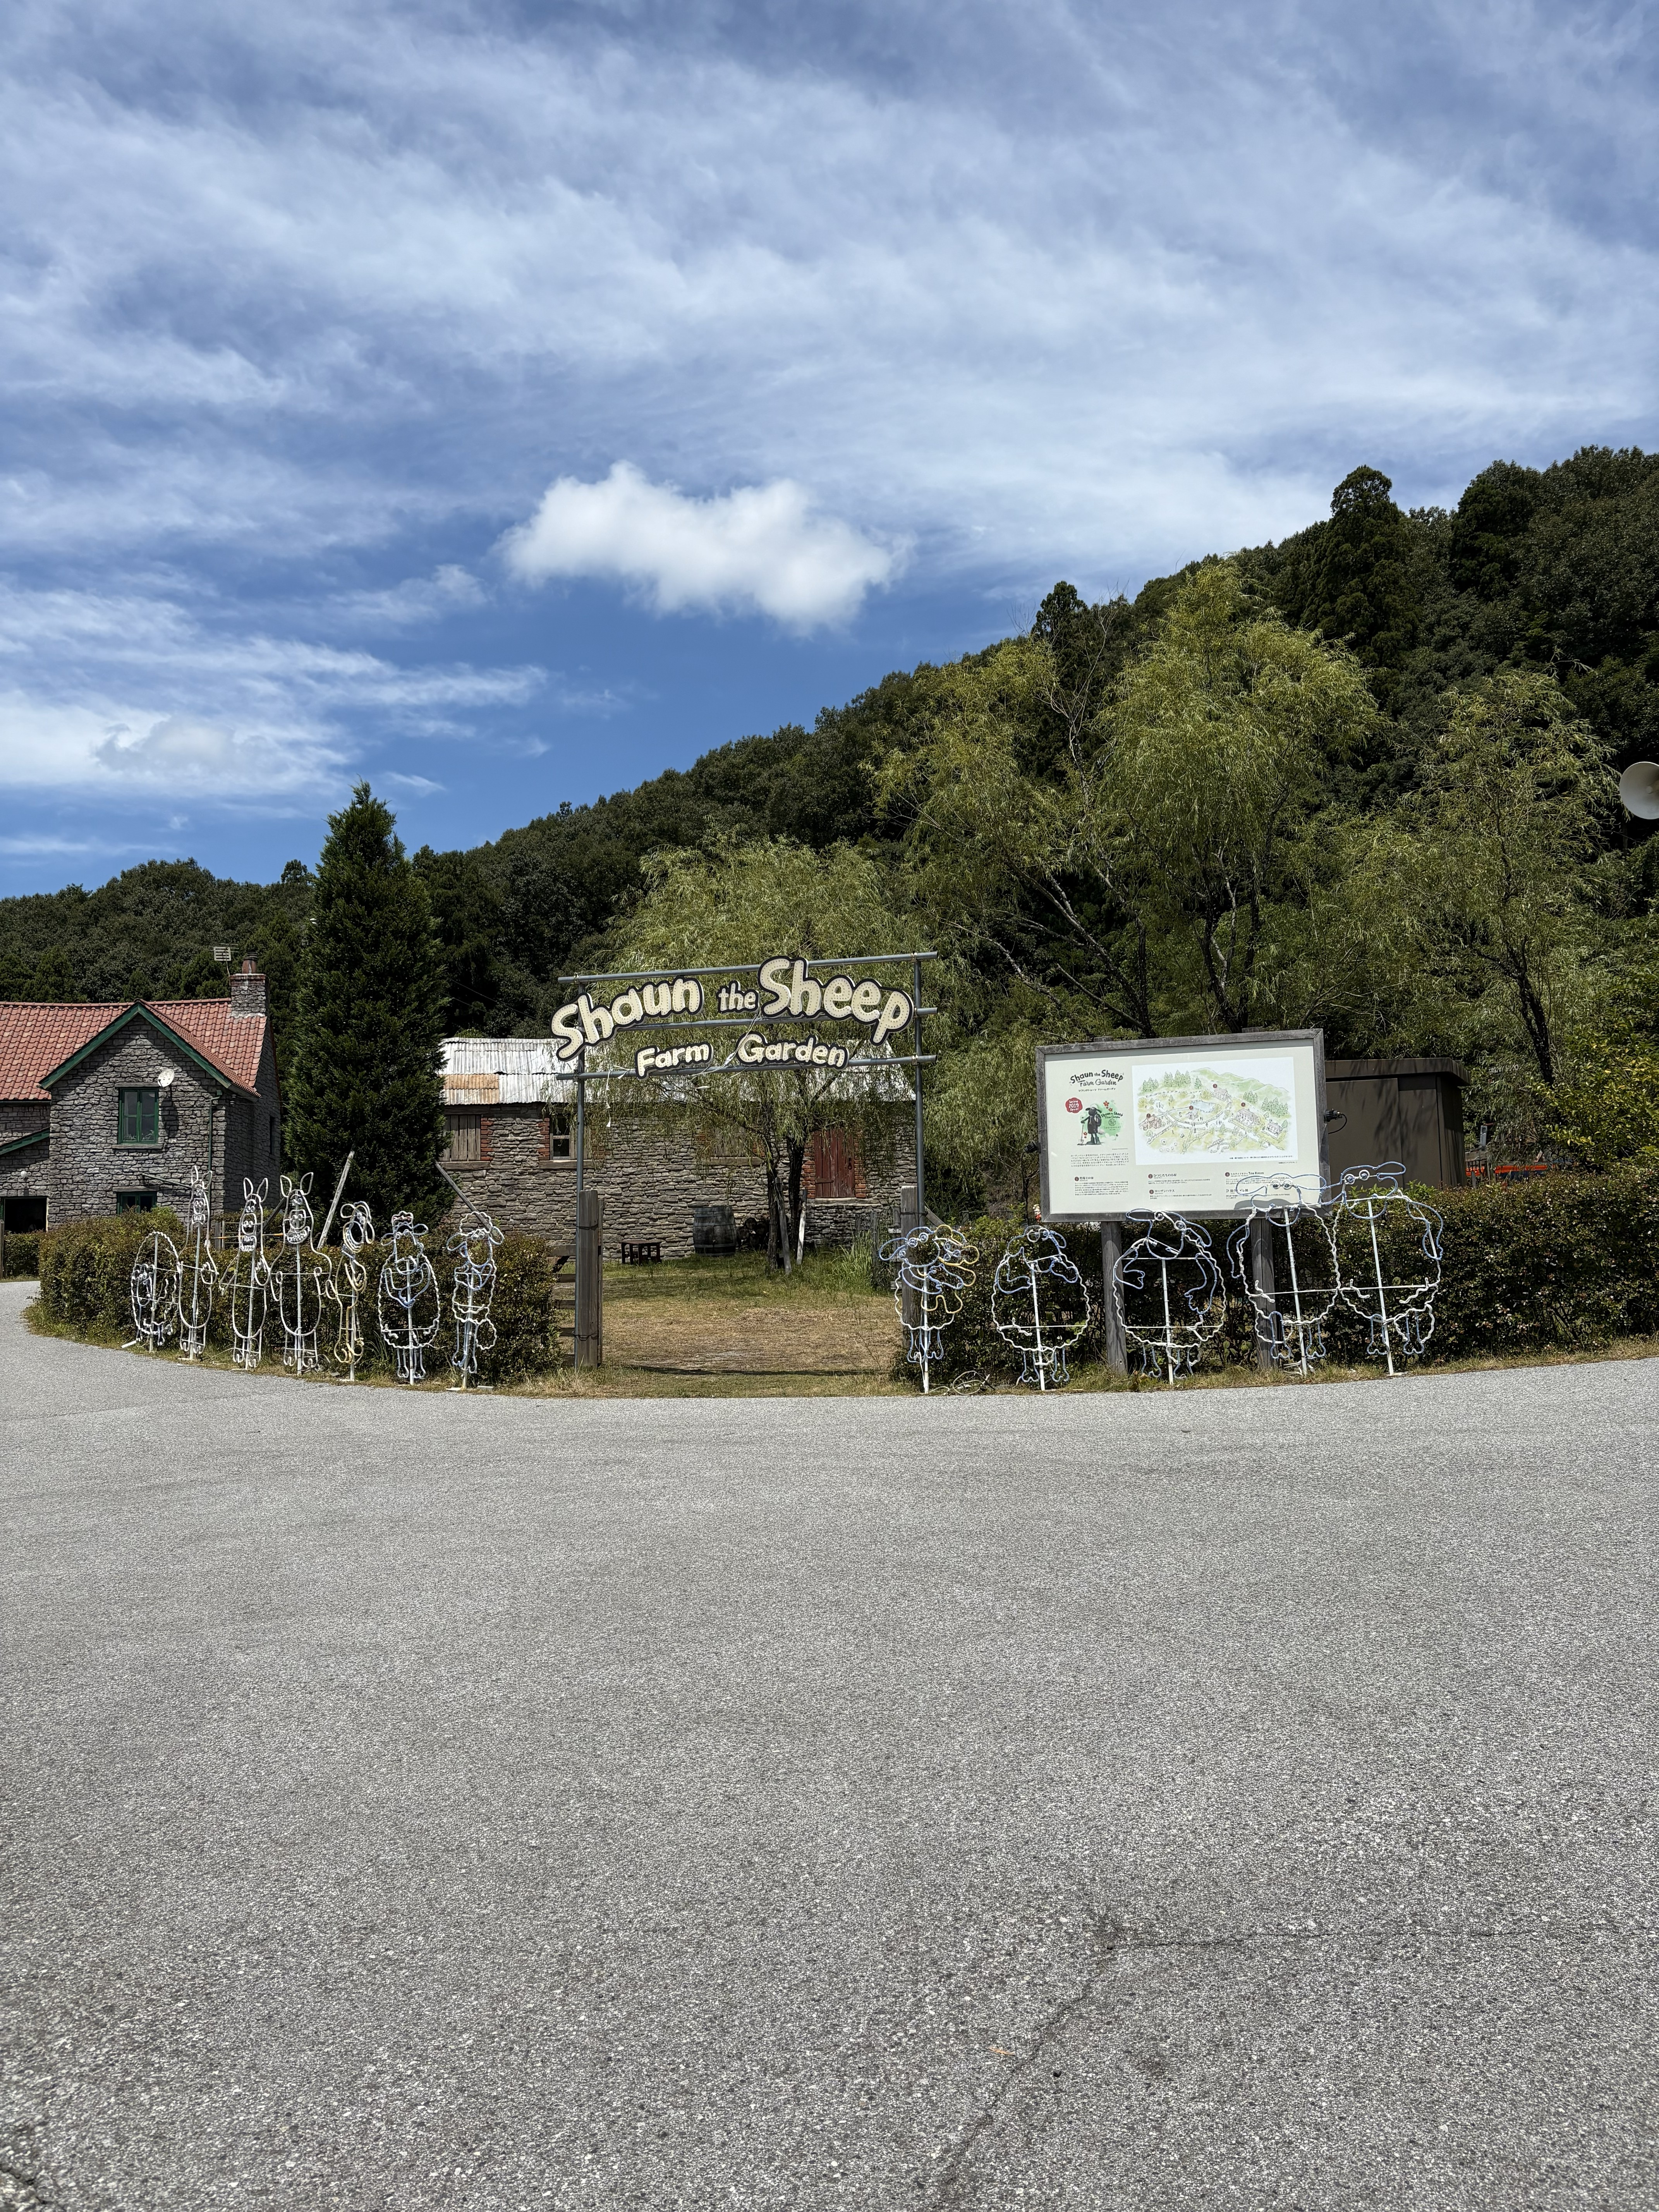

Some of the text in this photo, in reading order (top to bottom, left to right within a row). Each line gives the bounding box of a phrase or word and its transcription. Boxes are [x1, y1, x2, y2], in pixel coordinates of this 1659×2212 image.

[550, 957, 912, 1060] Shaun the Sheep
[636, 1032, 847, 1078] Farm Garden
[1070, 1072, 1093, 1084] Shaun
[1101, 1069, 1123, 1082] Sheep
